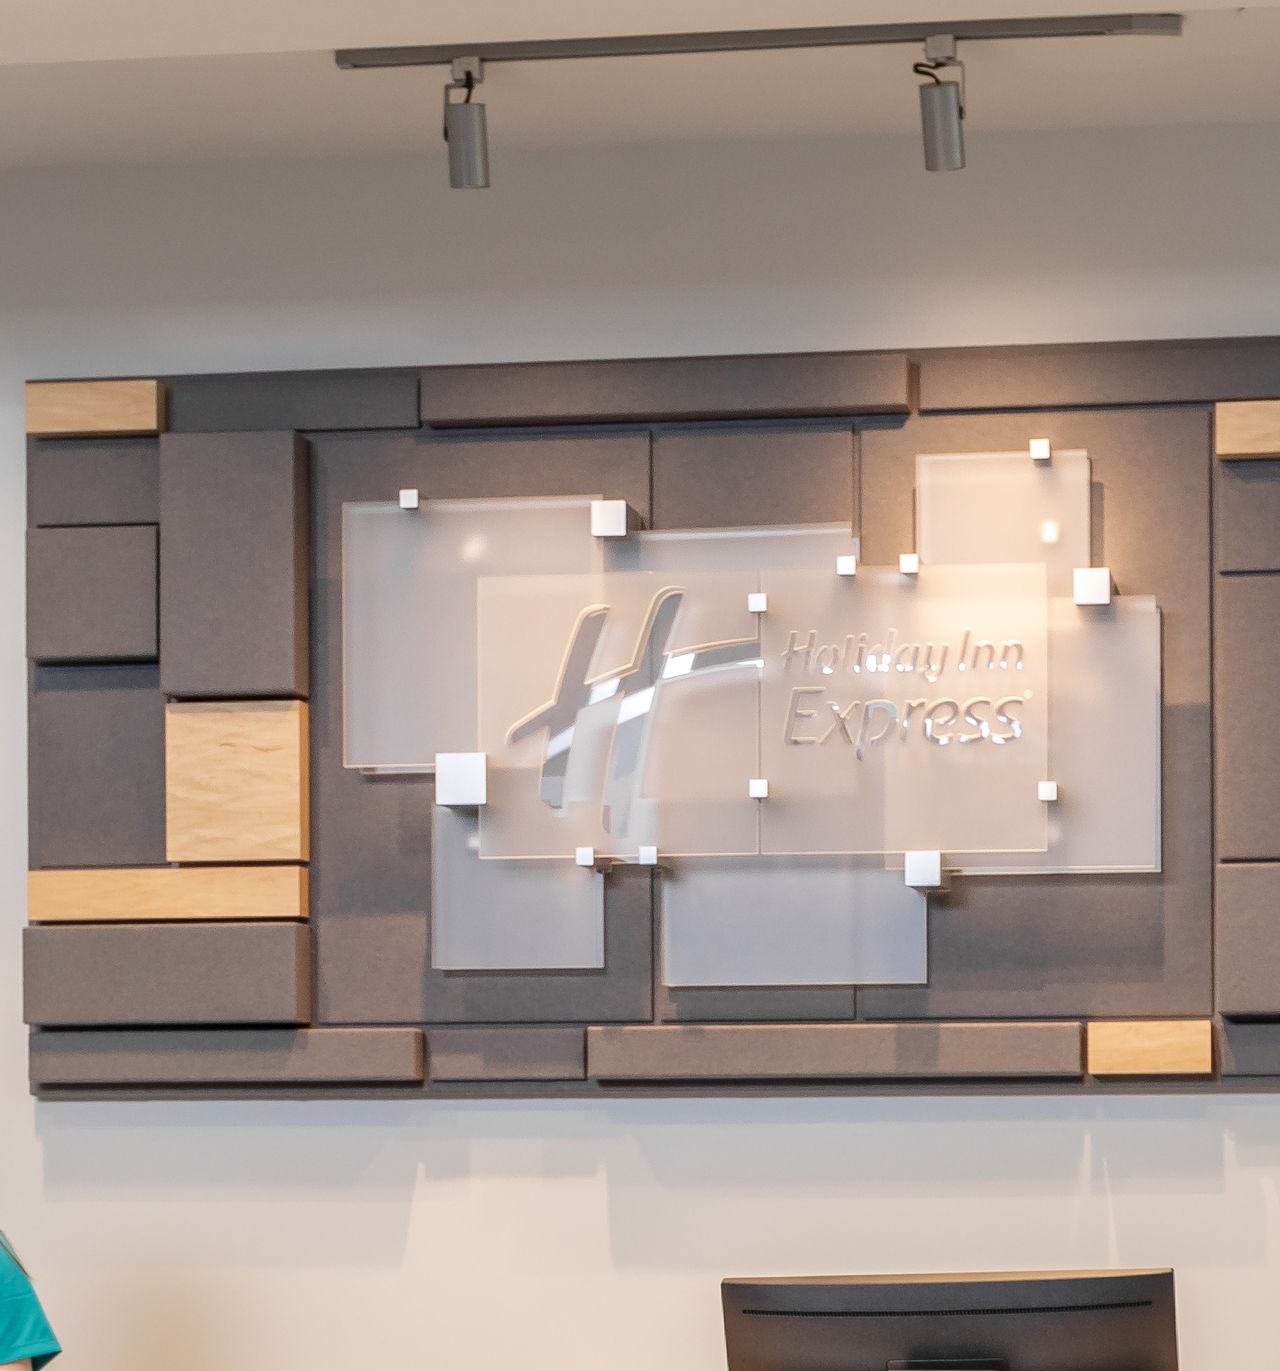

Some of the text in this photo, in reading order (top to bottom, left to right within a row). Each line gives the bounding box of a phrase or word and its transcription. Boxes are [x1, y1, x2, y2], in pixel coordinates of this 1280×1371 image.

[781, 626, 1025, 683] Holiday Inn
[783, 686, 1026, 762] Express
